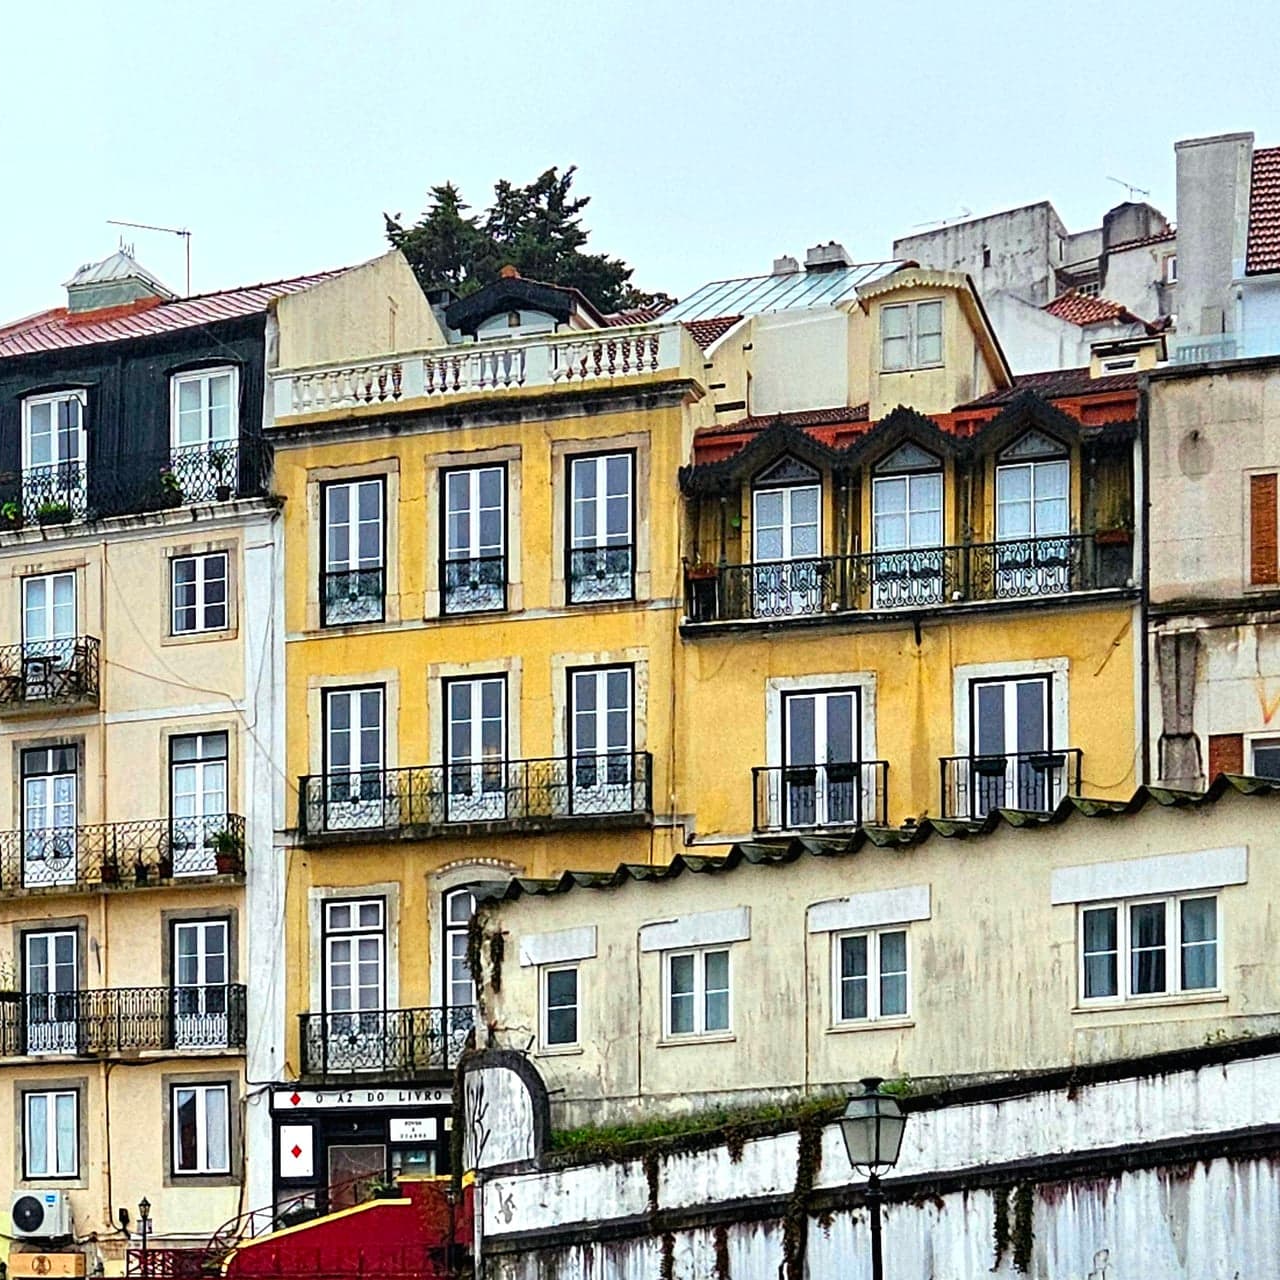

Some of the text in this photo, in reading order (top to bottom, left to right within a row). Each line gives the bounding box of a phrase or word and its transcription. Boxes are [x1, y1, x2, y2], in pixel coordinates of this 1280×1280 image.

[316, 1090, 442, 1103] O AZ DO LIVRO
